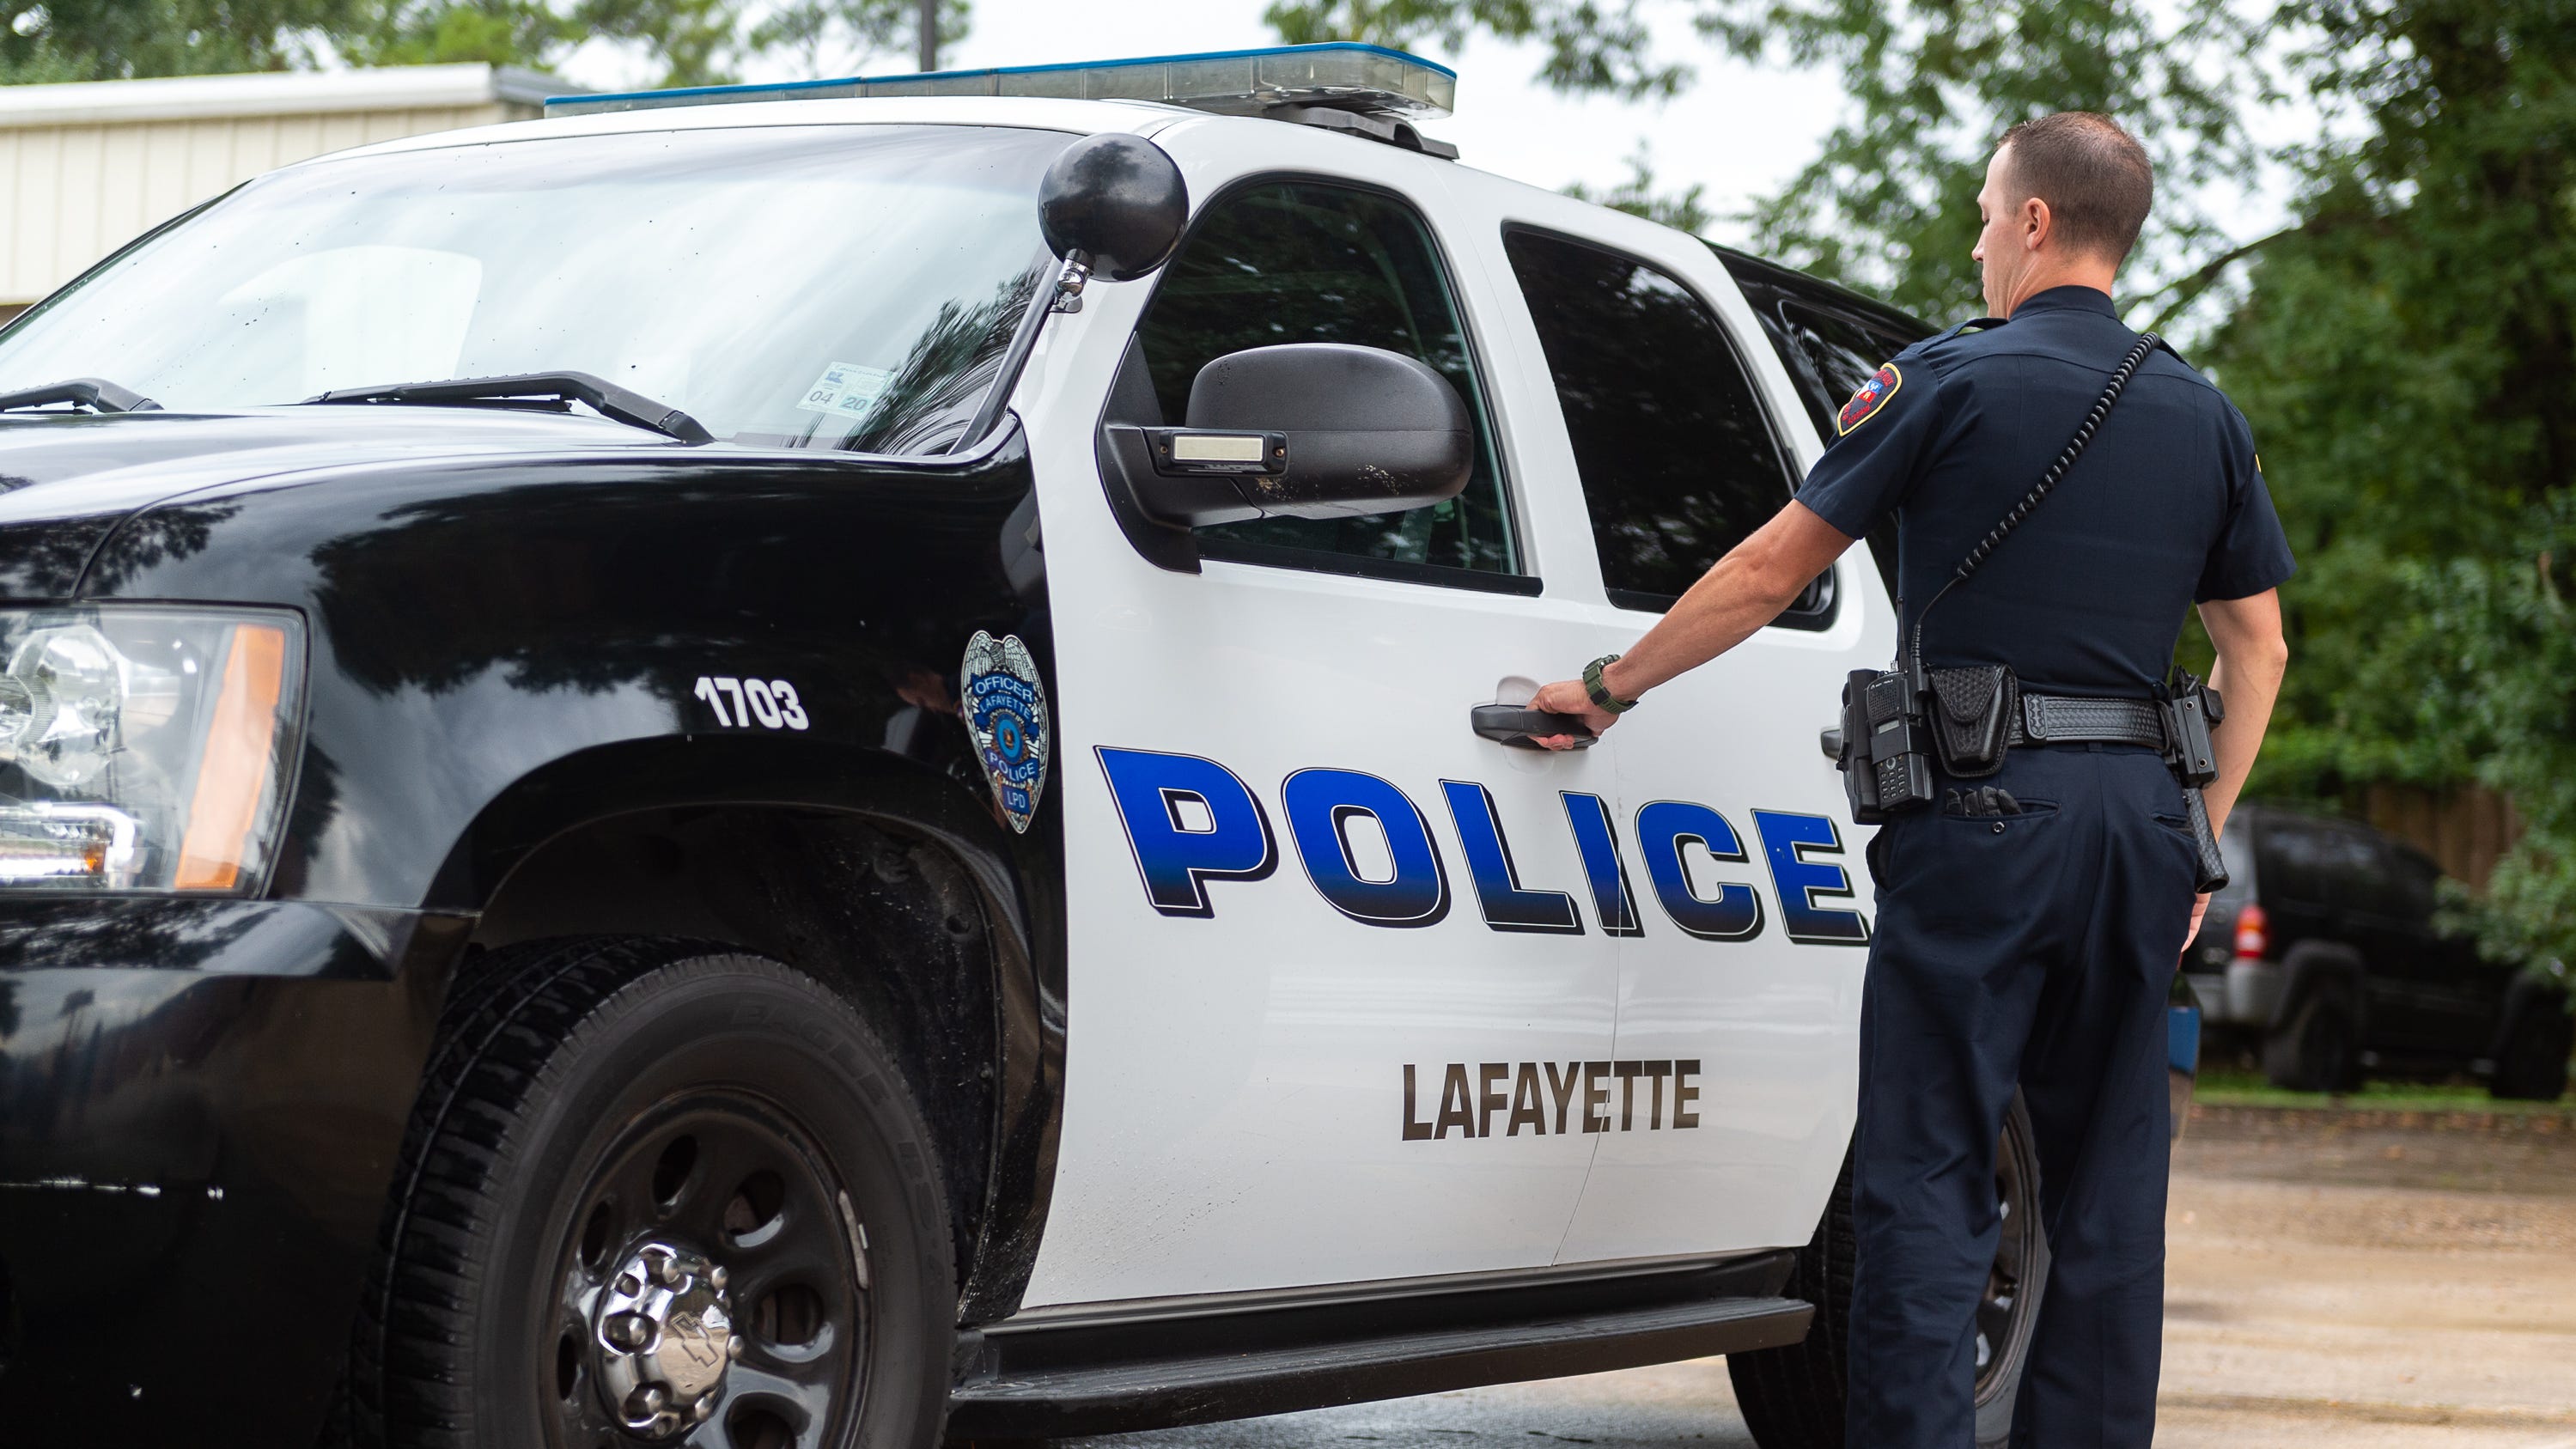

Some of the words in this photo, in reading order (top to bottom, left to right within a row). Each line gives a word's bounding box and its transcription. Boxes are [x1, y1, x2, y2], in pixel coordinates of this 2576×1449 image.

[809, 391, 834, 405] 04
[842, 397, 868, 411] 20
[694, 677, 809, 730] 1703
[975, 676, 1032, 703] OFFICER
[979, 695, 1031, 719] LAFAYETTE
[990, 752, 1036, 782] POLICE
[1007, 790, 1026, 808] LPD
[1093, 745, 1871, 947] POLICE
[728, 998, 892, 1106] EAGLE
[1402, 1059, 1701, 1141] LAFAYETTE
